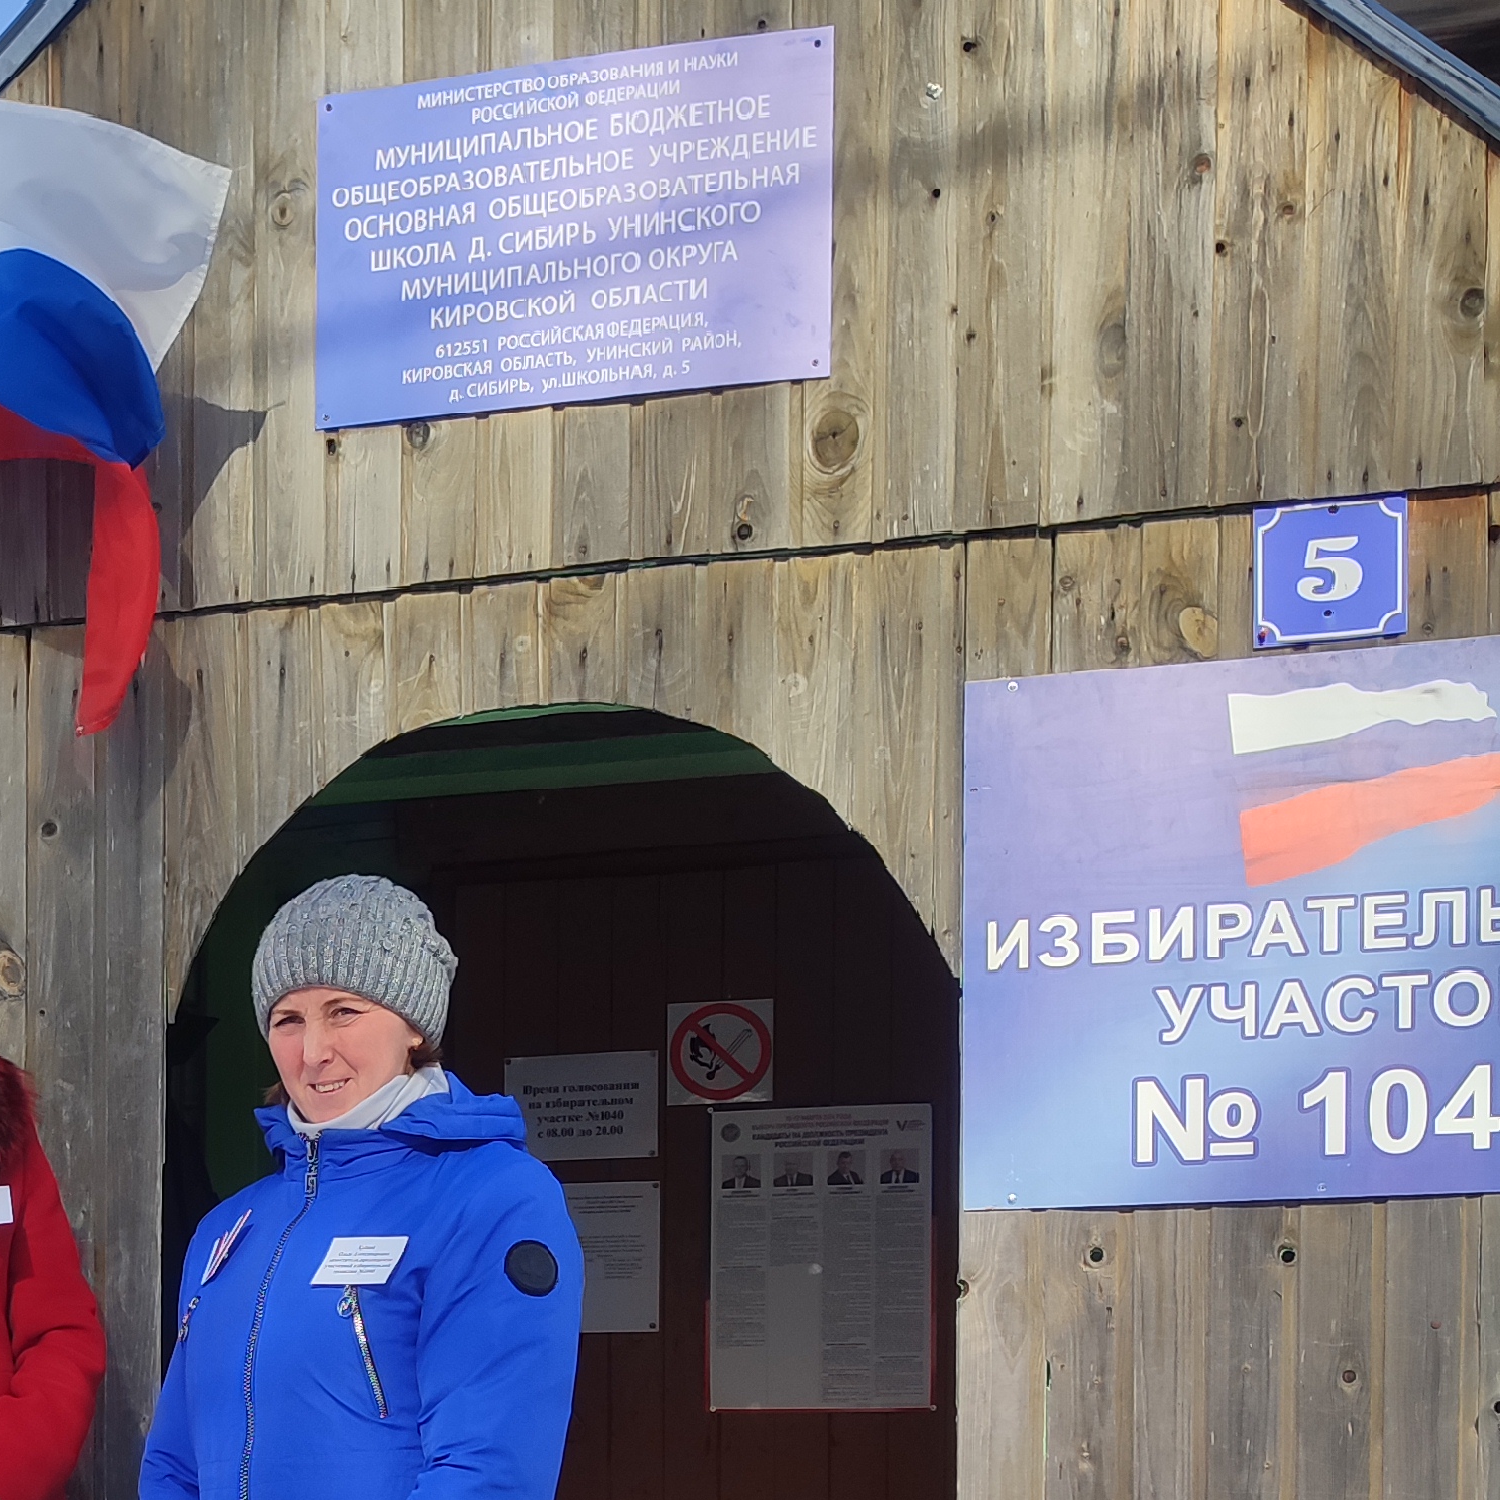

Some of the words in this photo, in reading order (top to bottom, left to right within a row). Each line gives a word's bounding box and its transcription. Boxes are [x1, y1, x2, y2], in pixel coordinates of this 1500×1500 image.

[417, 77, 545, 110] МИНИСТЕРСТВО
[547, 61, 664, 89] ОБРАЗОВАНИЯ
[668, 59, 680, 75] И
[684, 52, 739, 72] НАУКИ
[472, 91, 579, 124] РОССИЙСКОЙ
[585, 80, 681, 107] ФЕДЕРАЦИИ
[375, 118, 599, 171] МУНИЦИПАЛЬНОЕ
[610, 94, 771, 137] БЮДЖЕТНОЕ
[331, 148, 634, 207] ОБЩЕОБРАЗОВАТЕЛЬНОЕ
[649, 126, 817, 167] УЧРЕЖДЕНИЕ
[344, 202, 476, 241] ОСНОВНАЯ
[488, 162, 800, 220] ОБЩЕОБРАЗОВАТЕЛЬНАЯ
[370, 241, 456, 272] ШКОЛА
[468, 236, 492, 264] Д.
[498, 221, 597, 255] СИБИРЬ
[608, 201, 761, 241] УНИНСКОГО
[401, 251, 642, 302] МУНИЦИПАЛЬНОГО
[649, 240, 738, 270] ОКРУГА
[430, 290, 576, 330] КИРОВСКОЙ
[591, 277, 708, 310] ОБЛАСТИ
[402, 359, 492, 385] КИРОВСКАЯ
[500, 351, 577, 372] ОБЛАСТЬ,
[587, 337, 673, 363] УНИНСКИЙ
[682, 330, 742, 352] РАЙОН,
[435, 339, 488, 358] 612551
[498, 322, 604, 351] РОССИЙСКАЯ
[607, 312, 709, 338] ФЕДЕРАЦИЯ,
[449, 389, 464, 403] д.
[466, 377, 535, 398] СИБИРЬ,
[662, 364, 677, 378] д.
[681, 360, 691, 375] 5
[1296, 535, 1363, 602] 5
[523, 1085, 559, 1097] Время
[563, 1082, 639, 1093] голосования
[528, 1101, 541, 1109] на
[545, 1097, 634, 1109] избирательном
[1135, 1078, 1258, 1163] №
[1299, 1064, 1500, 1156] 104
[546, 1127, 575, 1138] 08.00
[578, 1128, 593, 1137] до
[595, 1125, 624, 1136] 20.00
